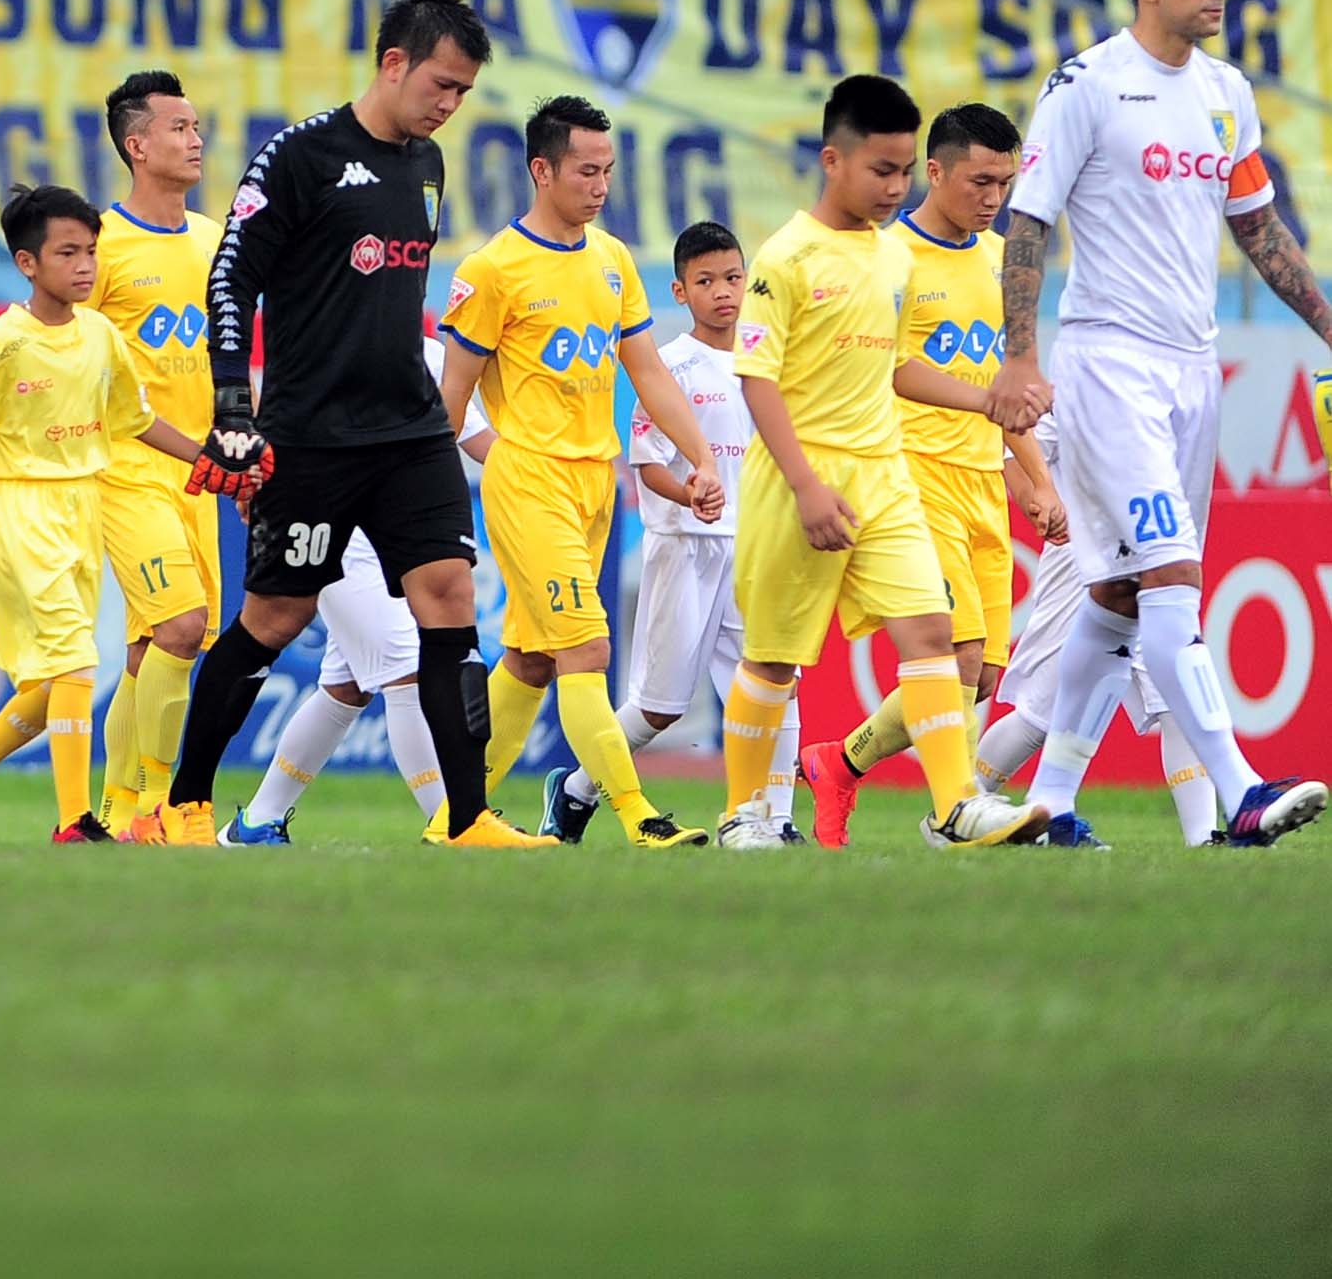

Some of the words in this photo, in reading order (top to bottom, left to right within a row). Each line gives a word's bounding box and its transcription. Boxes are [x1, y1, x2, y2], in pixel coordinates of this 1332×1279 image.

[528, 297, 558, 311] mitre
[917, 290, 947, 304] mitre
[156, 355, 208, 376] GROU
[30, 379, 54, 392] SCG
[706, 393, 727, 403] SCG
[725, 446, 748, 457] TOY
[1128, 491, 1178, 544] 20
[285, 522, 331, 568] 30
[139, 556, 170, 595] 17
[545, 577, 585, 614] 21
[850, 724, 875, 758] mitre
